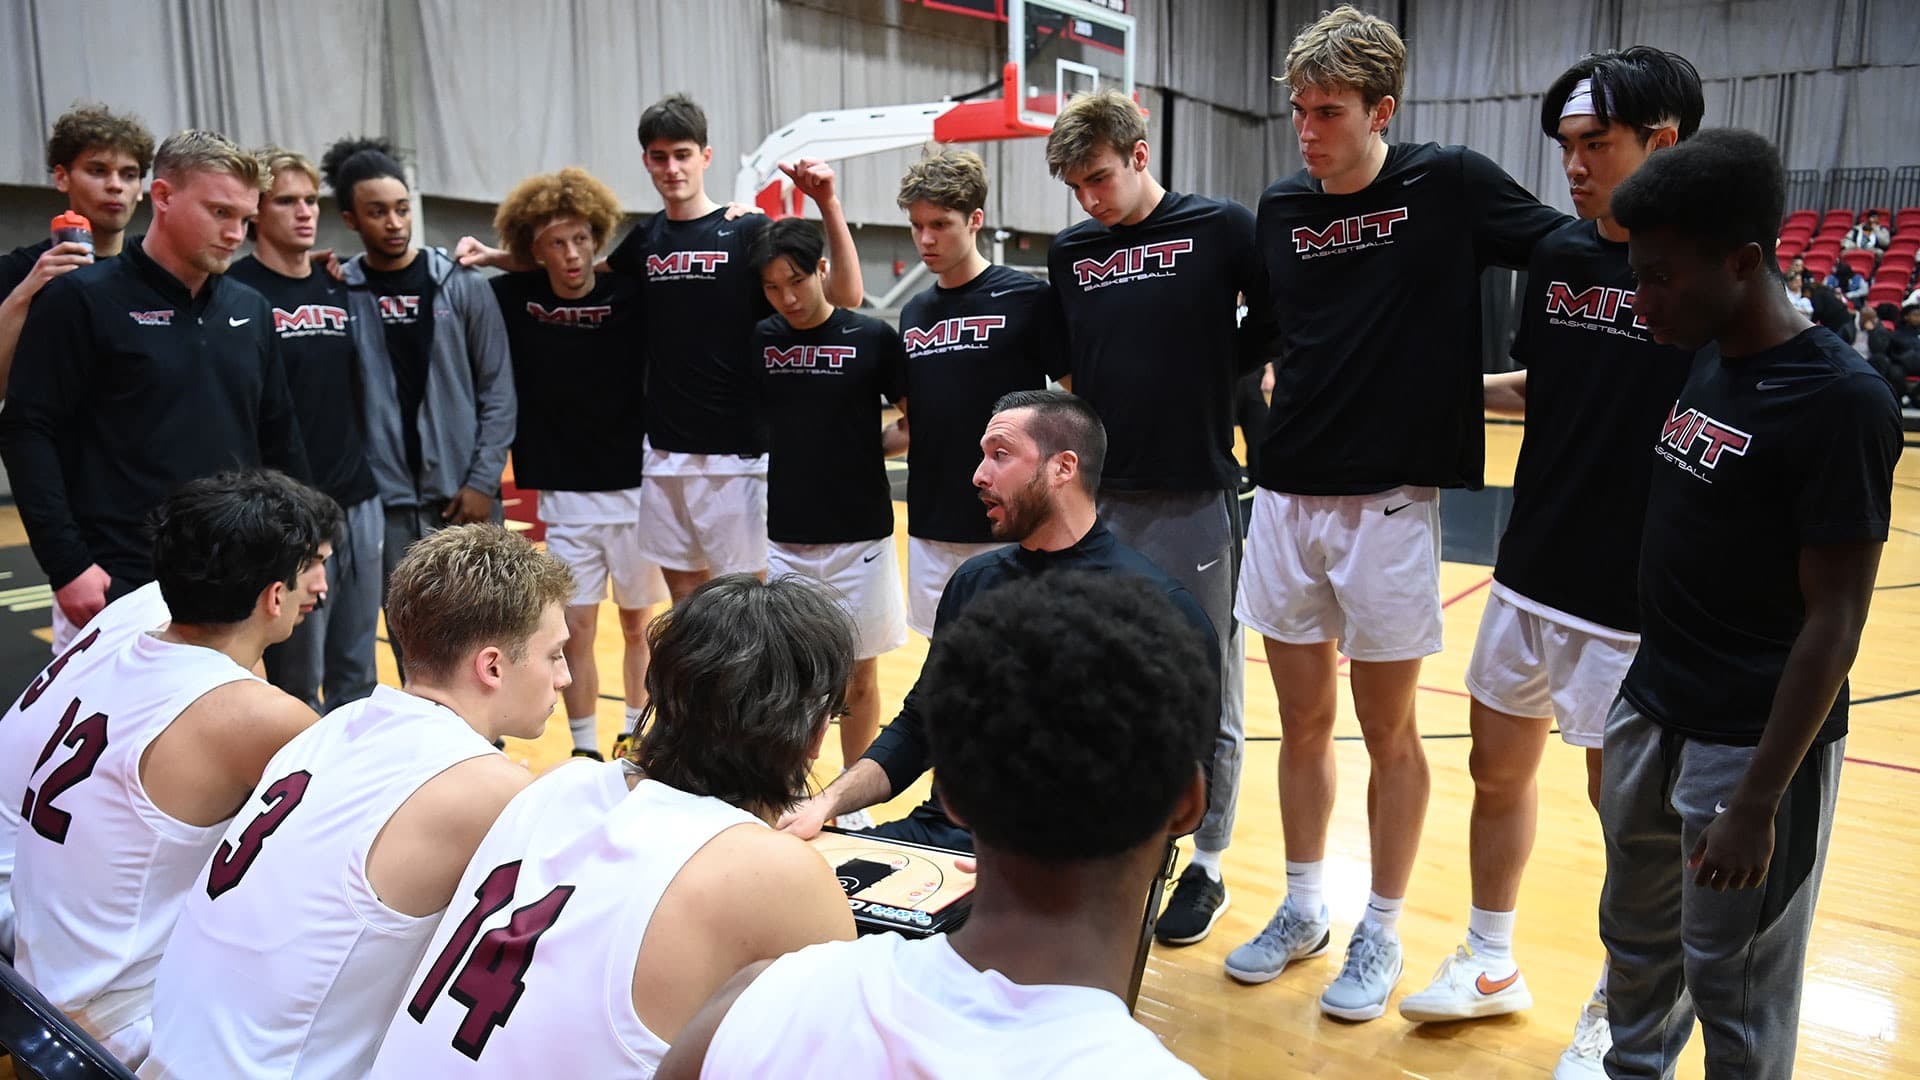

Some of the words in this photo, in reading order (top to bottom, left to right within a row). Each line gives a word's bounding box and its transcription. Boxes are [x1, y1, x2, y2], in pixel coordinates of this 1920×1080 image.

[1292, 207, 1408, 253] MIT
[1073, 239, 1193, 286] MIT
[1301, 239, 1395, 260] BASKETBALL
[646, 251, 729, 276] MIT
[1084, 271, 1177, 292] BASKETBALL
[272, 305, 348, 332] MIT
[527, 301, 612, 324] MIT
[904, 315, 1006, 353] MIT
[1549, 317, 1648, 342] BASKETBALL
[764, 345, 857, 368] MIT
[1654, 444, 1713, 484] SKETBALL
[206, 769, 313, 901] 3
[407, 859, 576, 1062] 14
